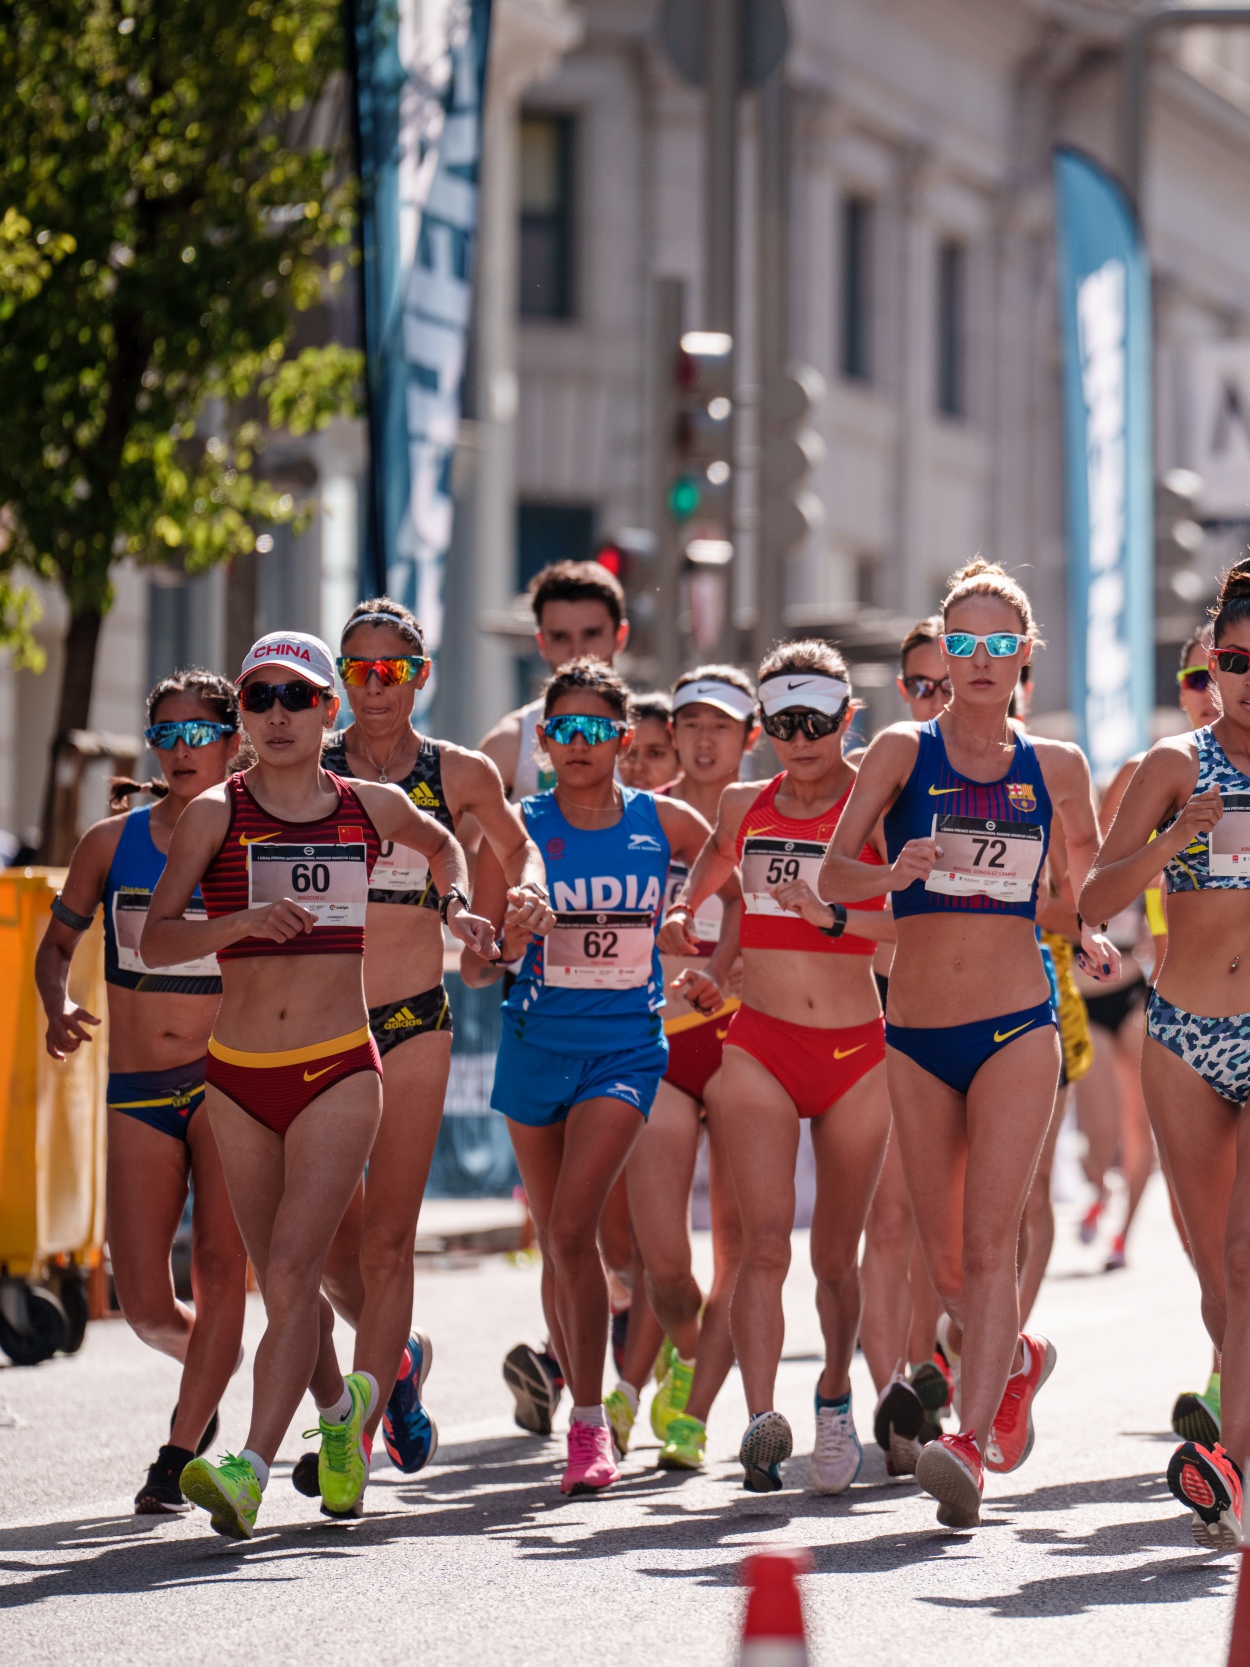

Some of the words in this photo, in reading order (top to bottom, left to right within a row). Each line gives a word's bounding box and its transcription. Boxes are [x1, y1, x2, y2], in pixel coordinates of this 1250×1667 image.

[253, 643, 311, 663] CHINA
[412, 796, 441, 807] didas
[971, 838, 1007, 869] 72
[291, 863, 331, 893] 60
[766, 858, 800, 884] 59
[953, 866, 972, 874] RAQUEL
[583, 930, 618, 959] 62
[383, 1018, 423, 1030] adidas
